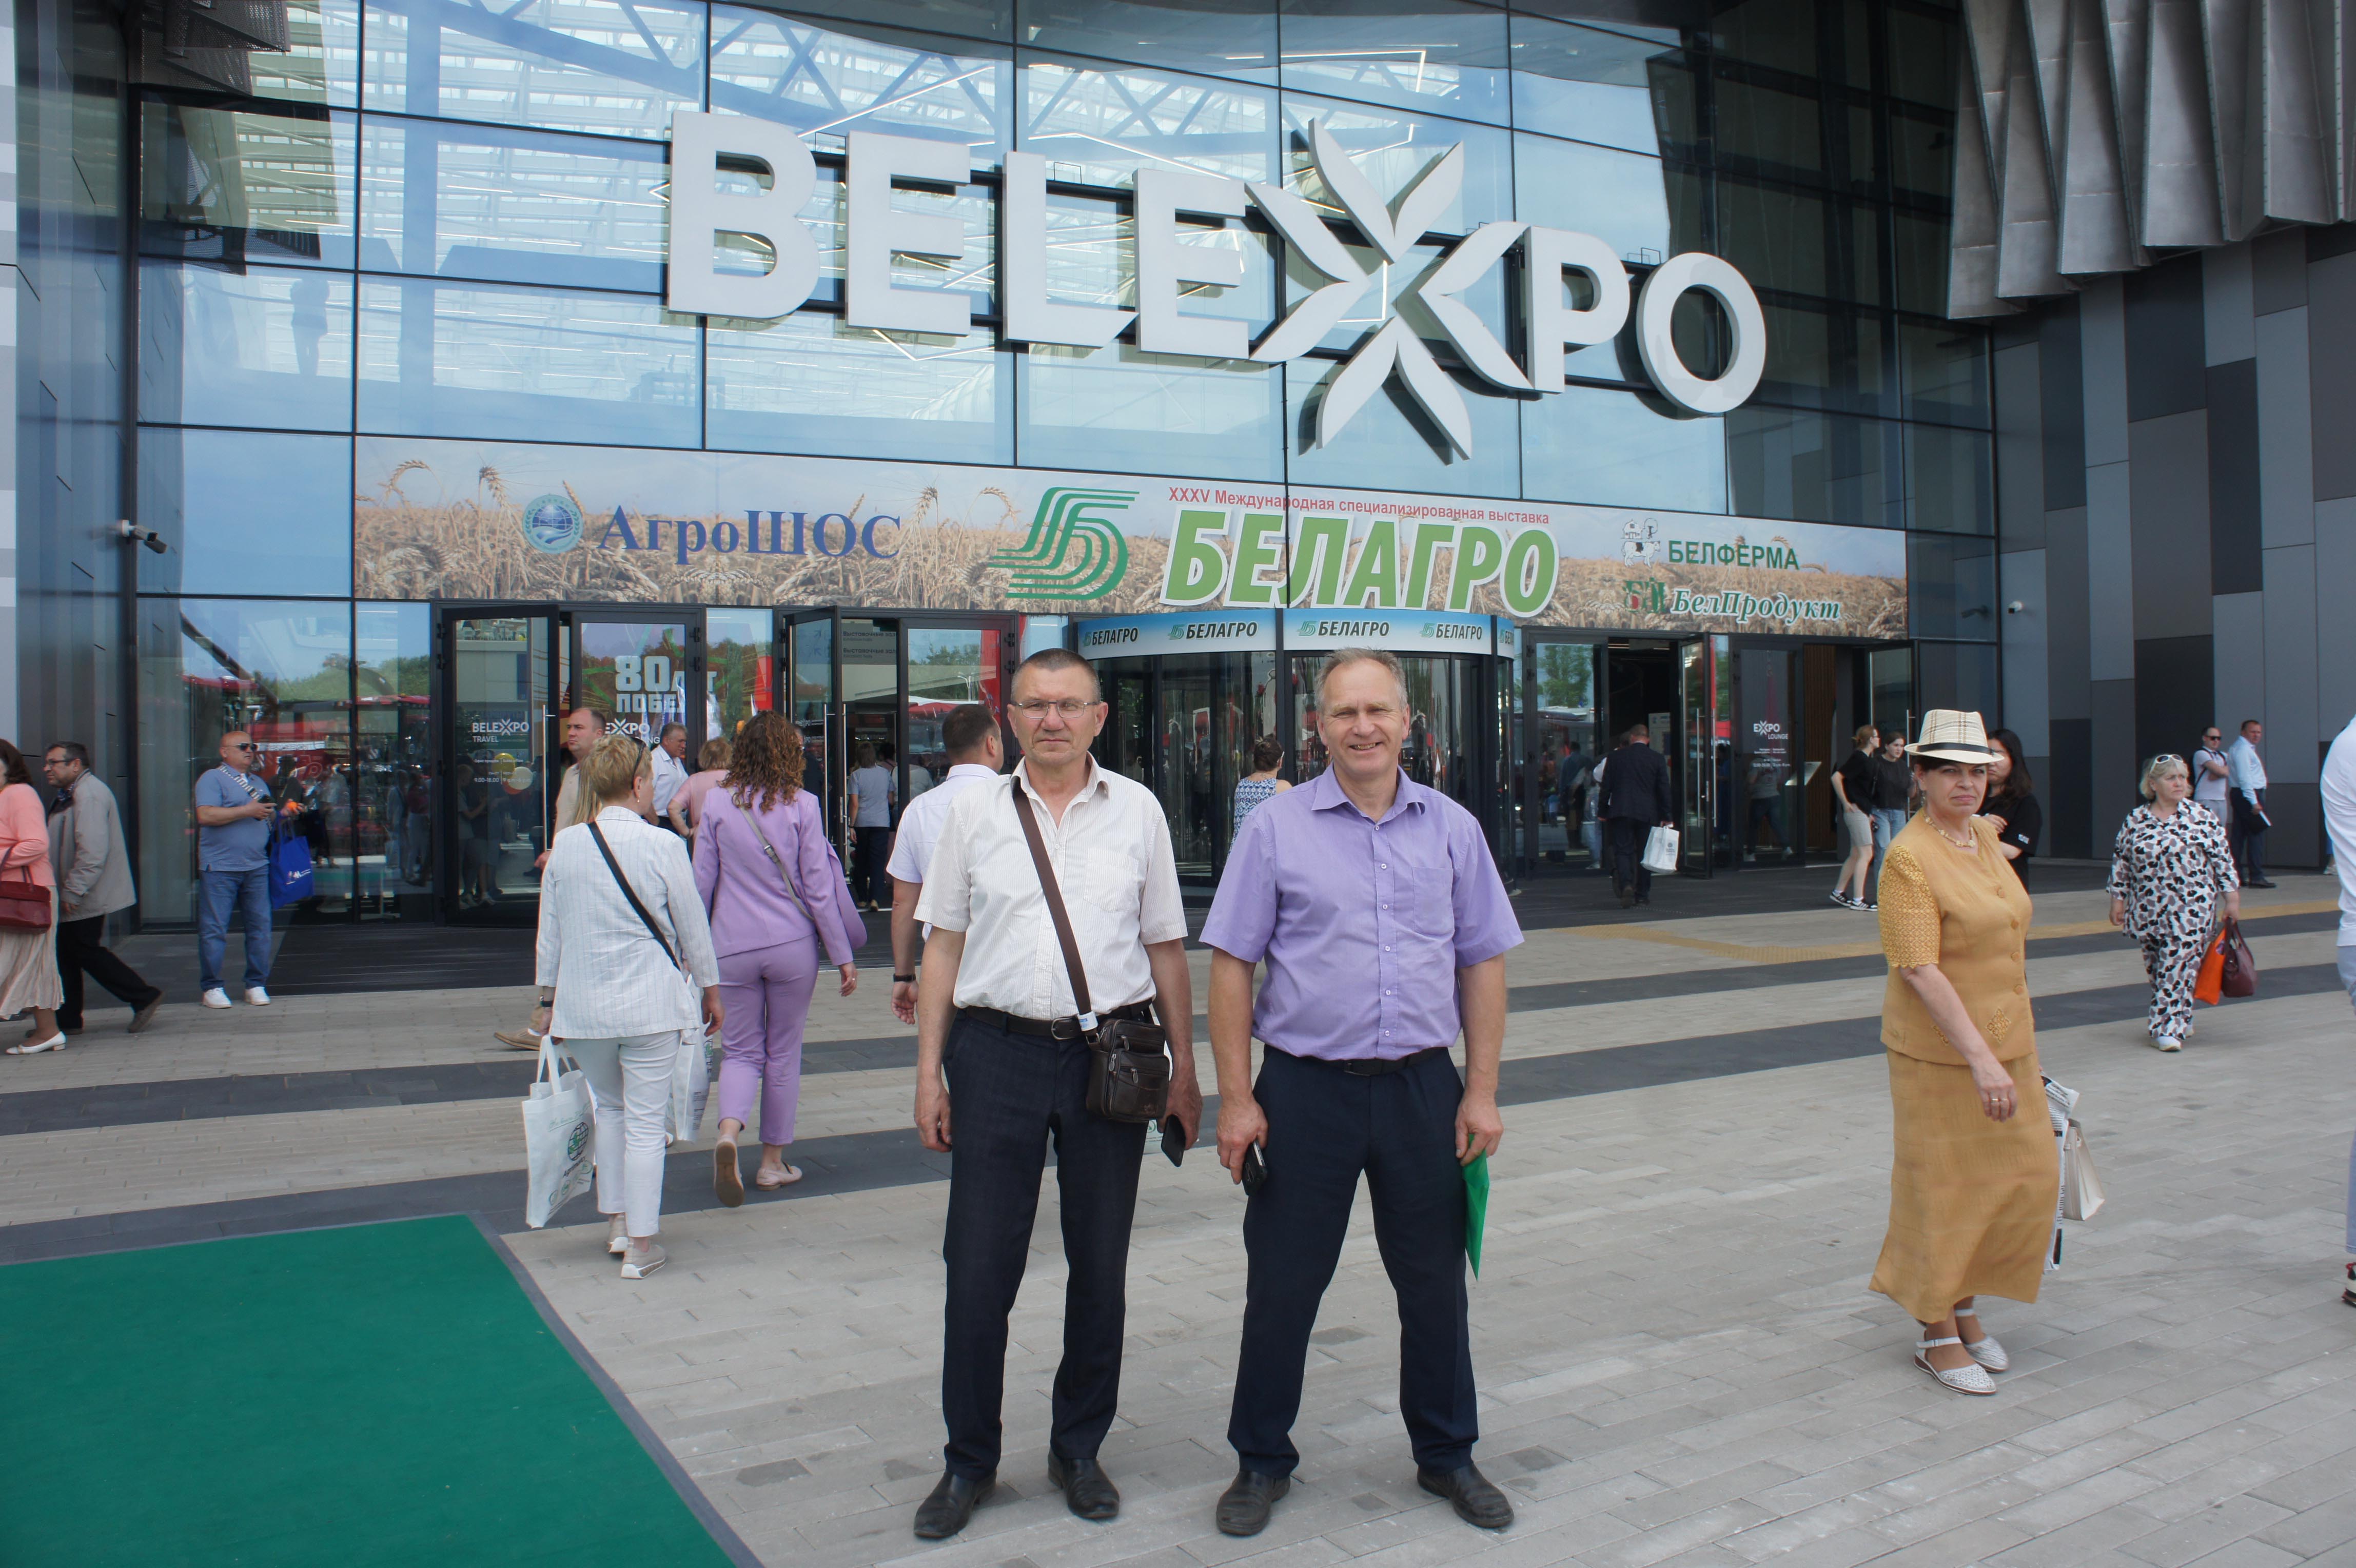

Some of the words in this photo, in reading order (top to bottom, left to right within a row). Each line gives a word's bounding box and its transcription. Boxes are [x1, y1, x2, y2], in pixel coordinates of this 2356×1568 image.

[668, 111, 1766, 460] BELEXPO
[1169, 487, 1210, 503] XXXV
[1215, 489, 1334, 512] Международная
[1339, 500, 1484, 520] специализированная
[1489, 511, 1549, 524] выставка
[597, 505, 901, 565] АгроШОС
[1163, 508, 1556, 614] БЕЛАГРО
[1668, 540, 1799, 570] БЕЛФЕРМА
[1672, 589, 1840, 625] БелПродукт
[1092, 627, 1138, 645] БЕЛАГРО
[1186, 622, 1258, 639] БЕЛАГРО
[1318, 621, 1389, 637] БЕЛАГРО
[1436, 623, 1482, 640] БЕЛАГРО
[616, 655, 670, 692] 80
[472, 718, 529, 736] BELEXPO
[1753, 720, 1780, 735] EXPO
